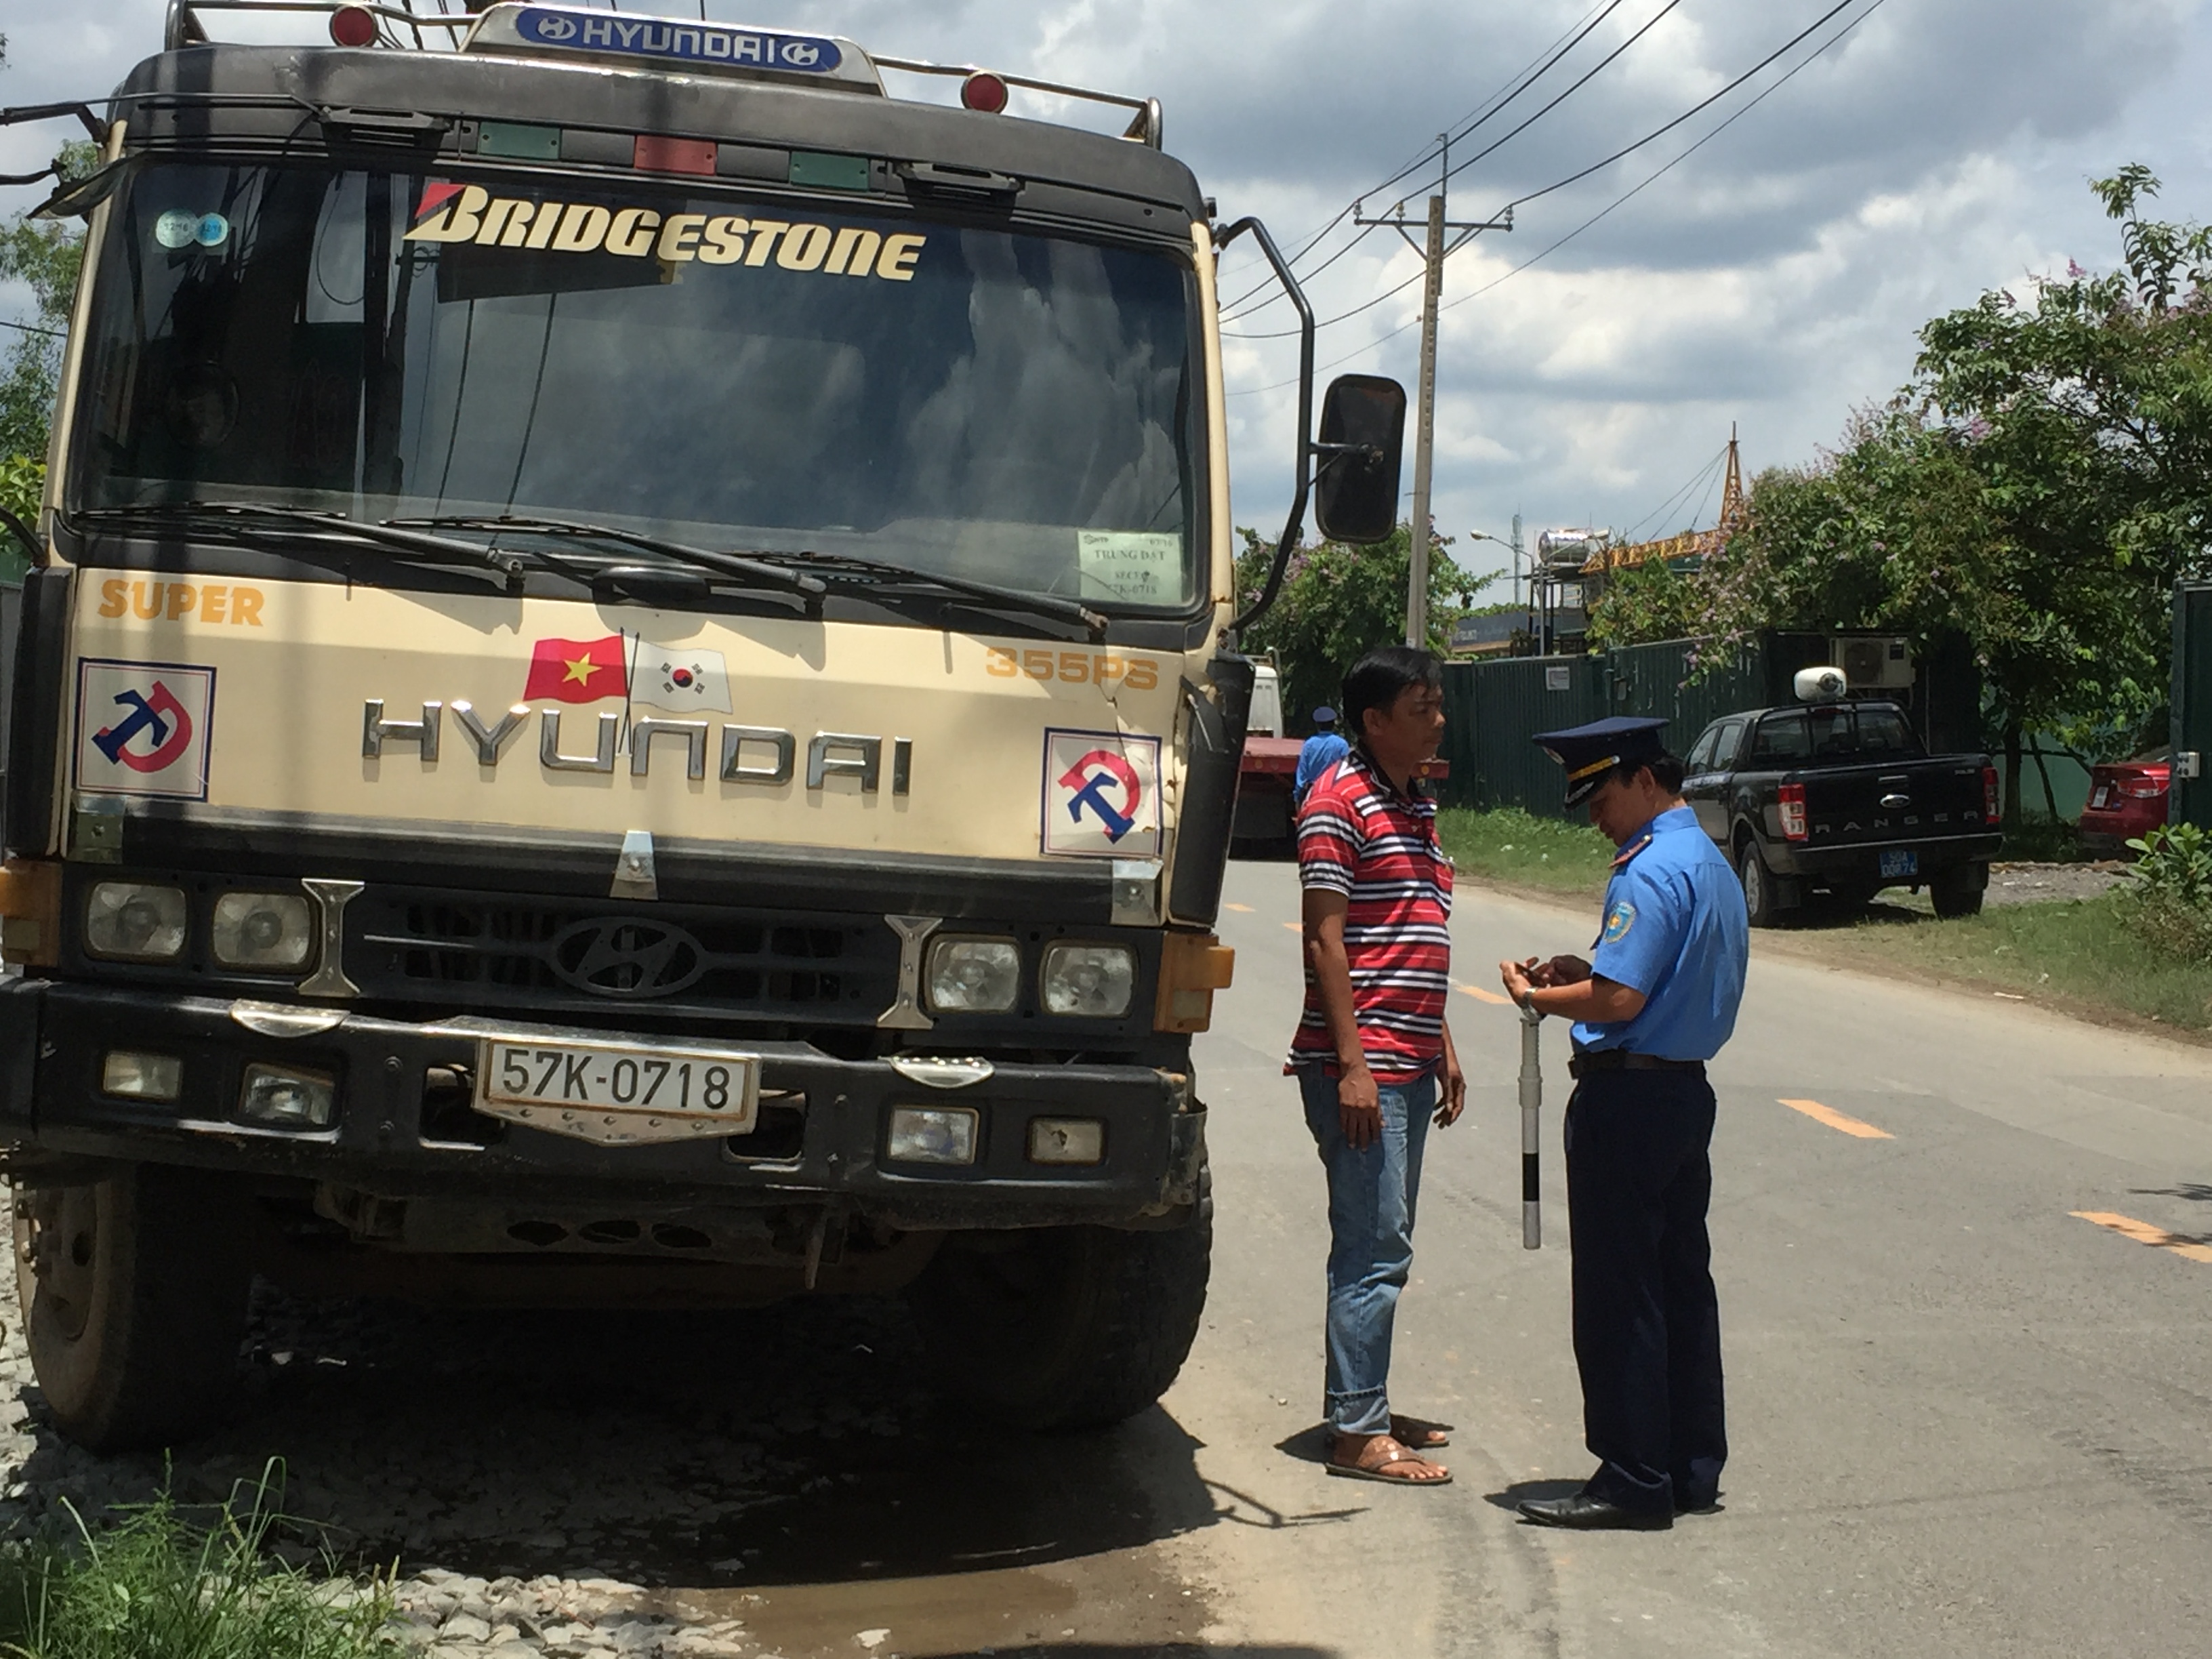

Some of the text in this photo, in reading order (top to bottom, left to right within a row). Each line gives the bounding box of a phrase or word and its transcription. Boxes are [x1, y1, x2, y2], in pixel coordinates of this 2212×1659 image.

[583, 19, 774, 63] HYUNDAI
[402, 184, 926, 281] BRIDGESTONE
[97, 579, 264, 627] SUPER
[986, 647, 1159, 691] 355PS
[361, 698, 912, 796] HYUNDAI
[1814, 811, 1978, 834] RANGER
[502, 1048, 731, 1110] 57K-0718
